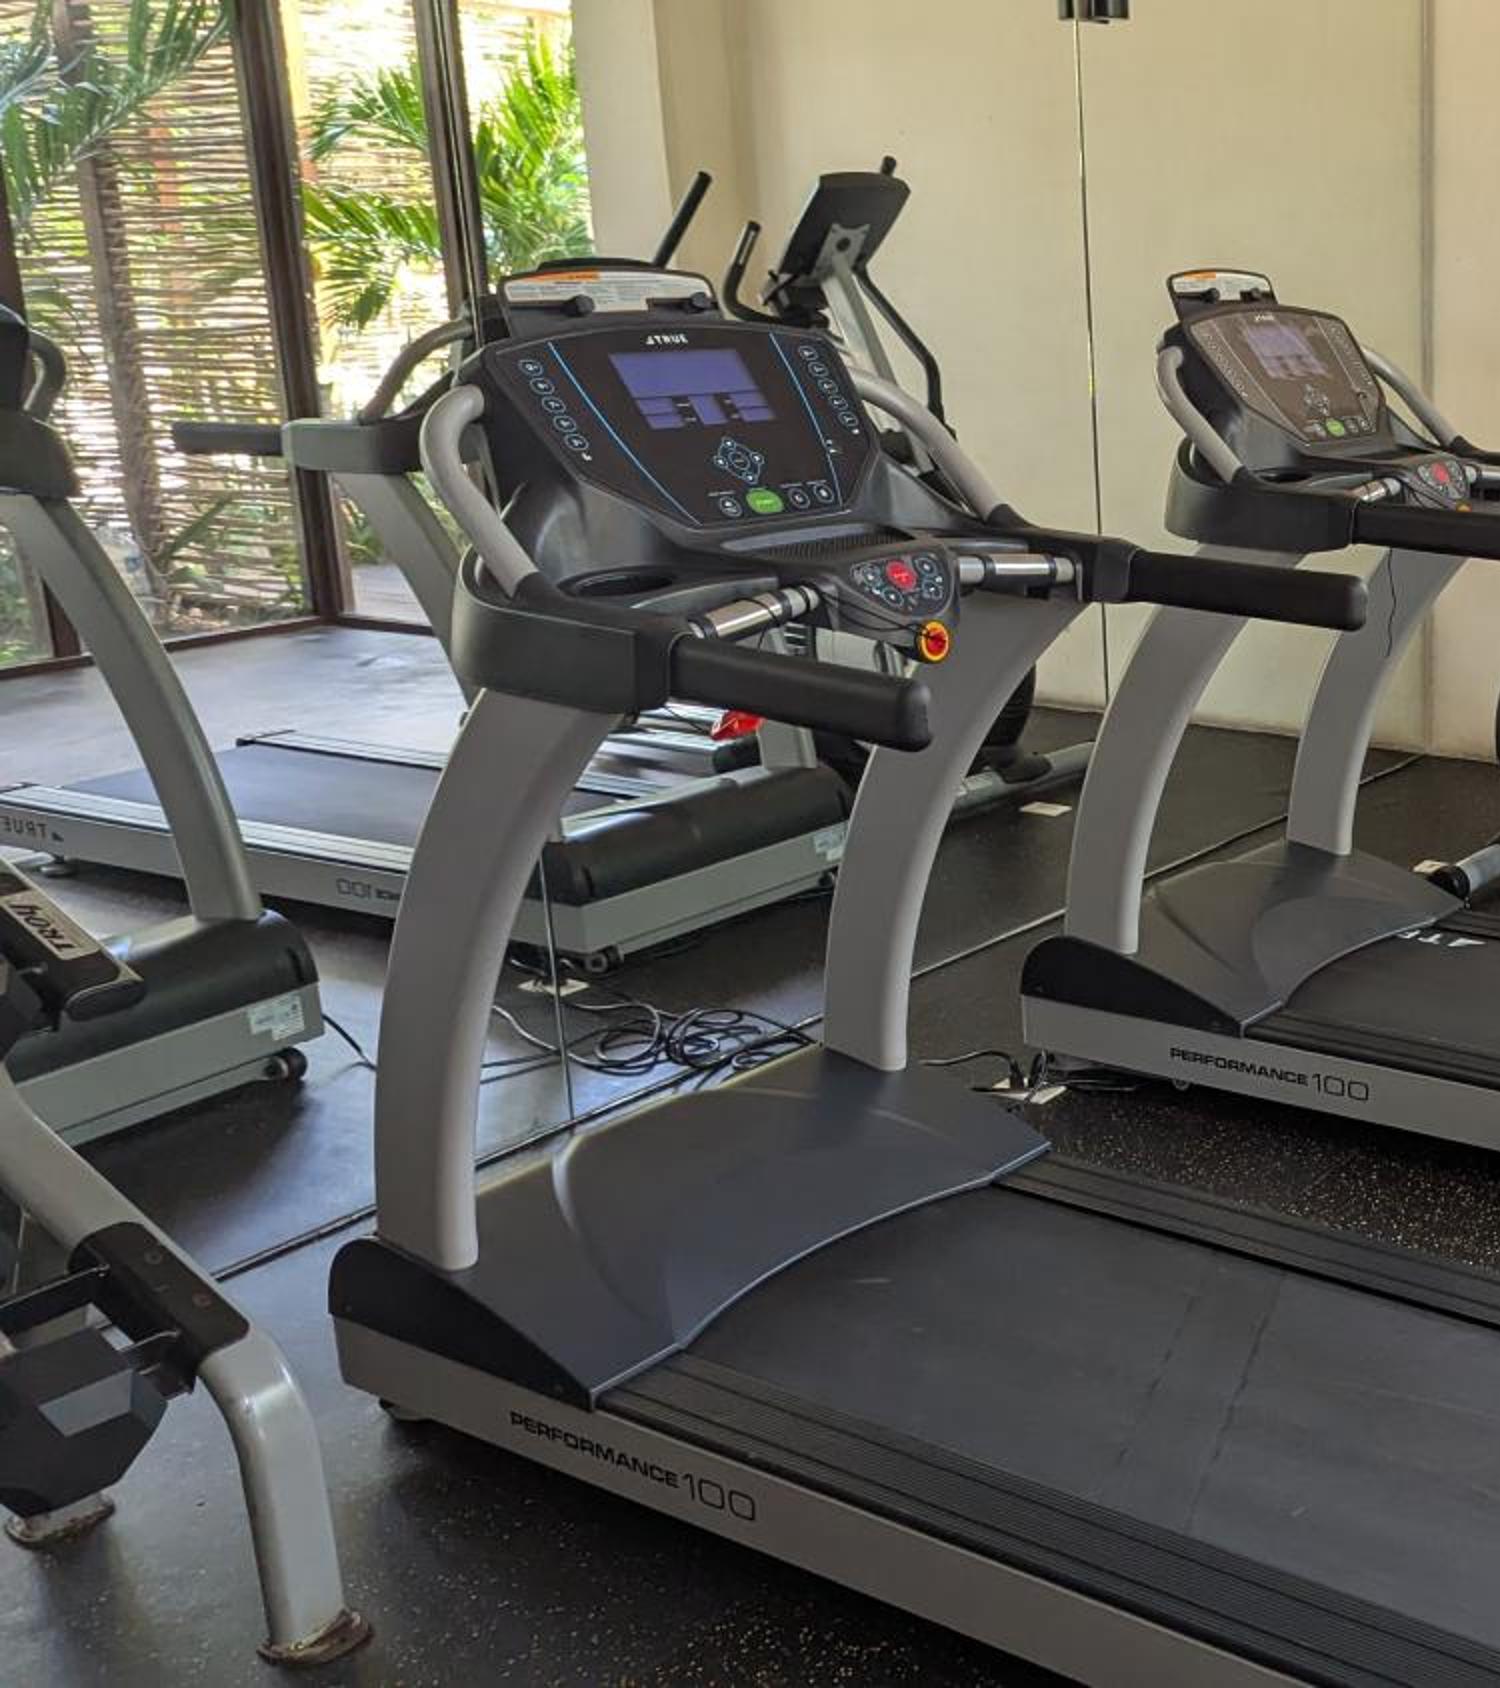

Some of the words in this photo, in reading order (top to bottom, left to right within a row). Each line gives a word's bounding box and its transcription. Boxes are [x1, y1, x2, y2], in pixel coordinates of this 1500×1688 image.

[1169, 1046, 1309, 1087] PERFORMANCE
[1312, 1073, 1369, 1101] 100
[509, 1410, 680, 1489] PERFORMANCE
[683, 1472, 757, 1521] 100
